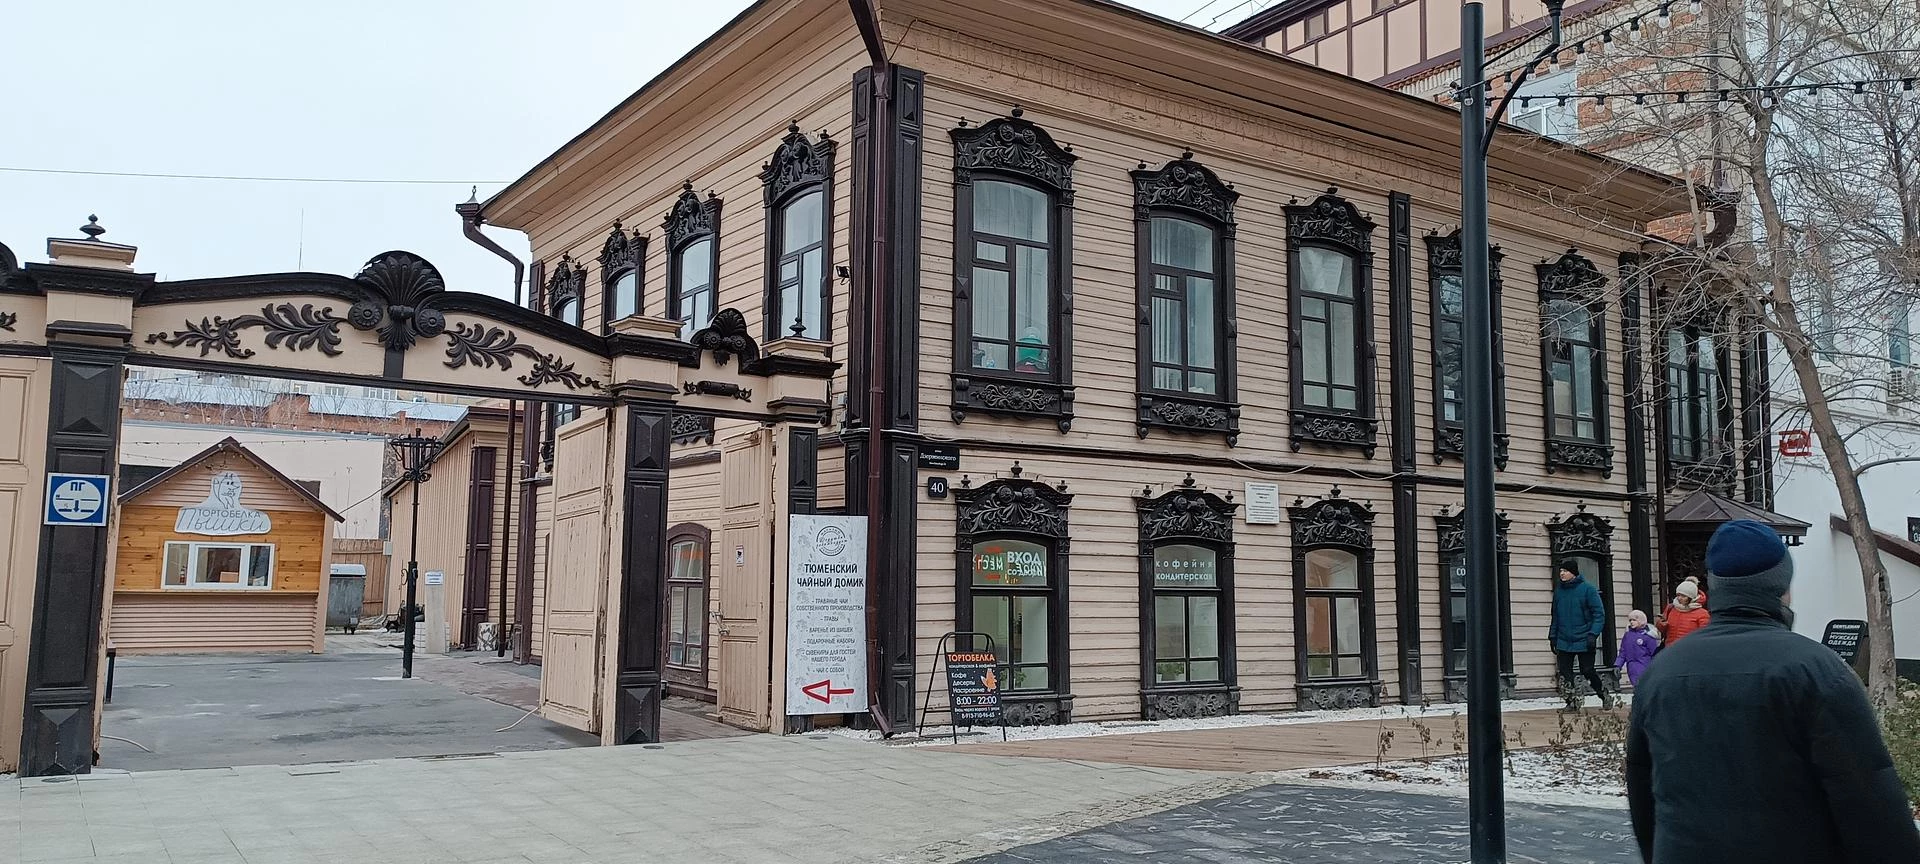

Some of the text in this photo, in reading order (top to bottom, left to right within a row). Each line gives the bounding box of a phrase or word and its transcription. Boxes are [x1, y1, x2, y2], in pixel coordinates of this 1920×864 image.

[70, 482, 86, 491] ПГ
[930, 482, 944, 493] 40
[199, 509, 261, 518] ТОРТОБЕЛКА
[1007, 551, 1040, 564] ВХОД
[804, 563, 858, 574] ТЮМЕНСКИЙ
[796, 577, 864, 588] ЧАЙНЫЙ ДОМИК
[956, 696, 972, 706] 8:00
[977, 695, 997, 705] 22:00
